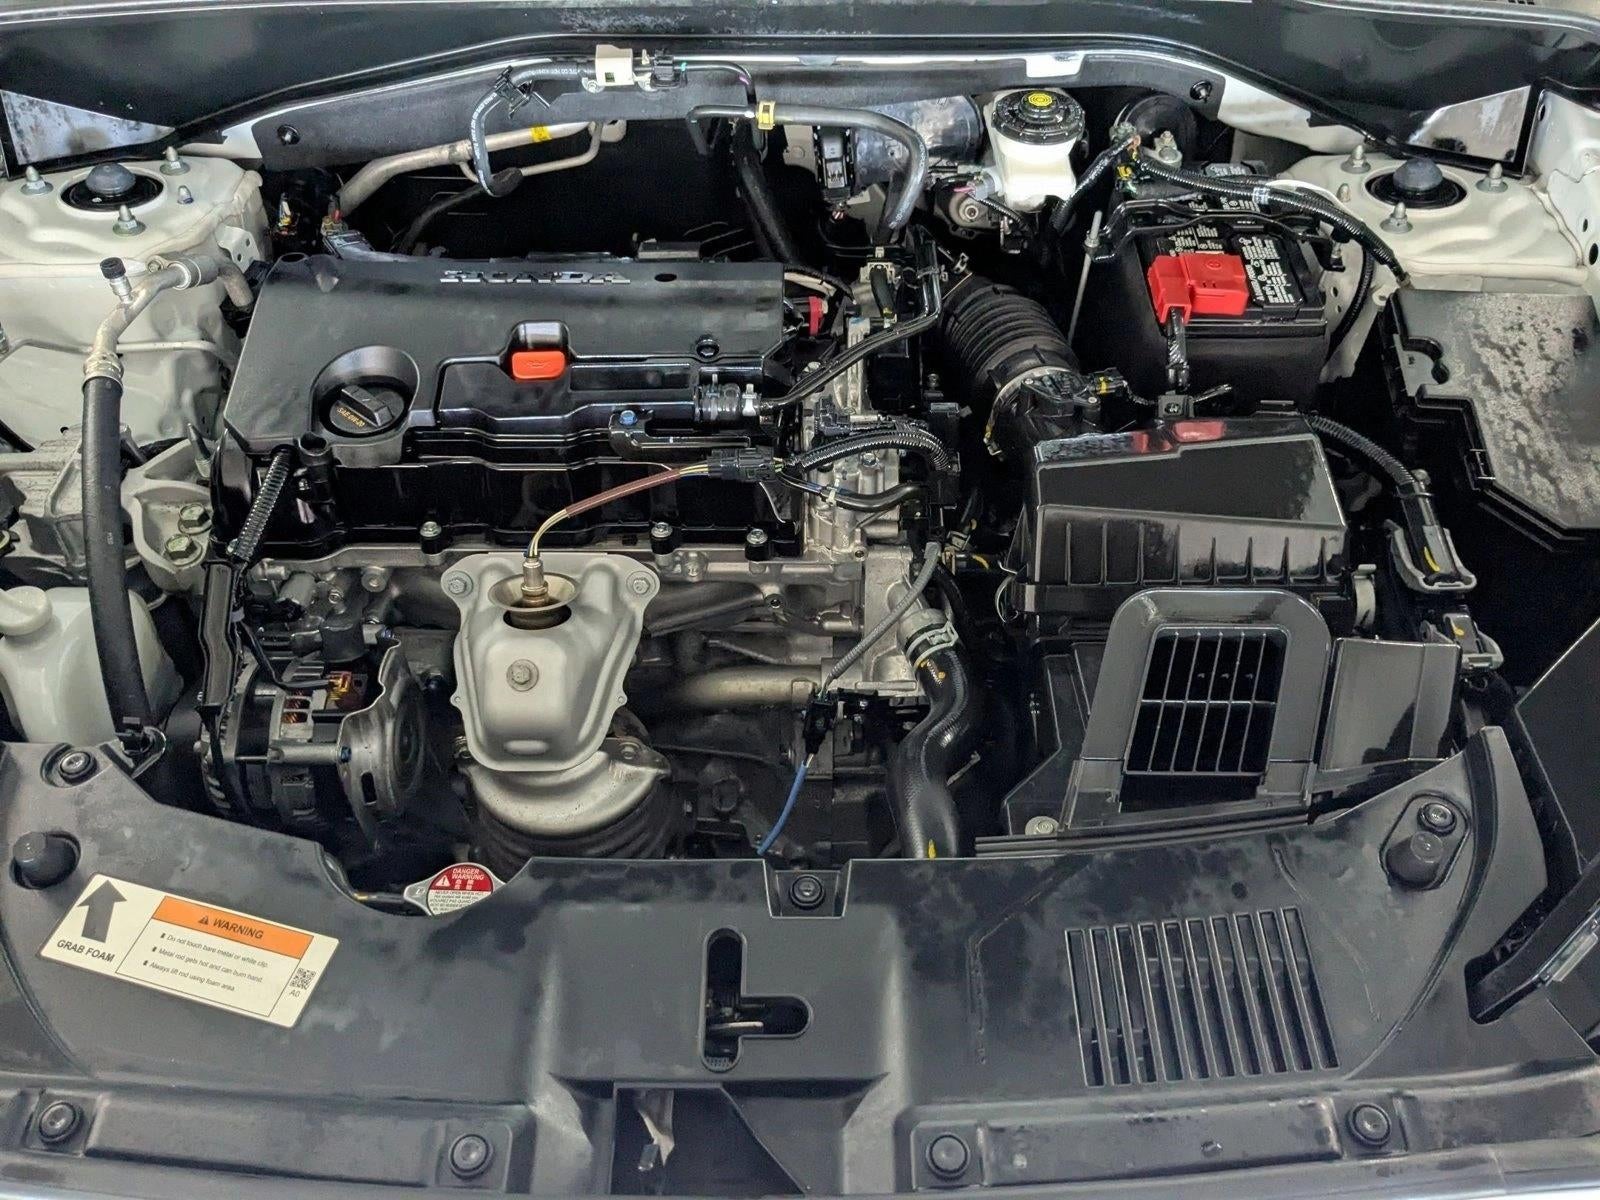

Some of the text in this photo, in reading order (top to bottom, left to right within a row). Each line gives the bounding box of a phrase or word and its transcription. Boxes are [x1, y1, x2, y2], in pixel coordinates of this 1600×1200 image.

[213, 918, 264, 940] WARNING
[57, 939, 116, 963] GRAB FOAM
[159, 947, 176, 958] Metal
[175, 952, 186, 961] rod
[184, 956, 199, 964] gets
[198, 958, 210, 967] hot
[209, 962, 222, 971] and
[232, 969, 247, 978] burn
[167, 934, 176, 942] Do
[176, 937, 187, 945] not
[186, 940, 203, 950] touch
[202, 944, 217, 953] bare
[217, 948, 234, 958] metal
[241, 955, 257, 965] white
[149, 961, 170, 973] Always
[169, 967, 179, 975] lift
[178, 970, 190, 978] rod
[188, 973, 206, 984] using
[205, 978, 221, 987] foam
